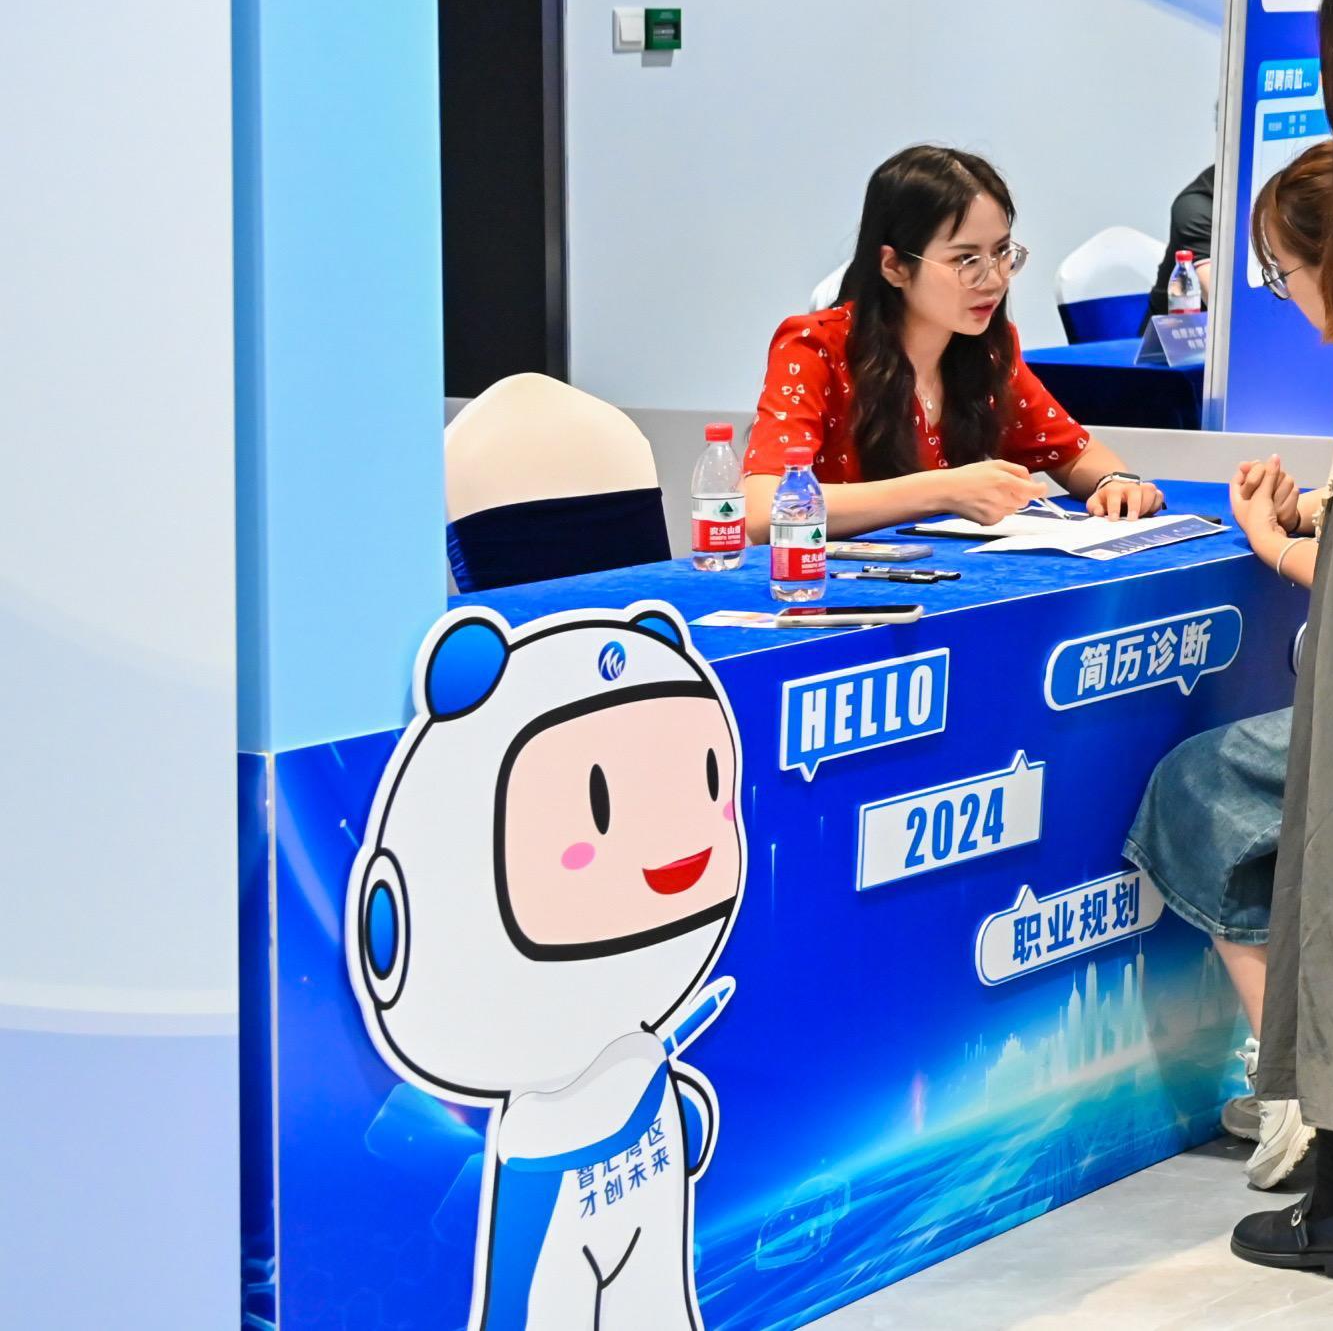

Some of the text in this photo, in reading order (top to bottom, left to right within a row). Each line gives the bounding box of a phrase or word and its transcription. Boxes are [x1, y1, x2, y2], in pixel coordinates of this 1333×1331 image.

[801, 553, 826, 564] 农夫山
[1076, 618, 1213, 696] 简历诊断
[800, 665, 933, 753] HELLO
[904, 786, 1005, 870] 2024
[1012, 881, 1140, 966] 职业规划
[579, 1145, 671, 1219] 才创未来
